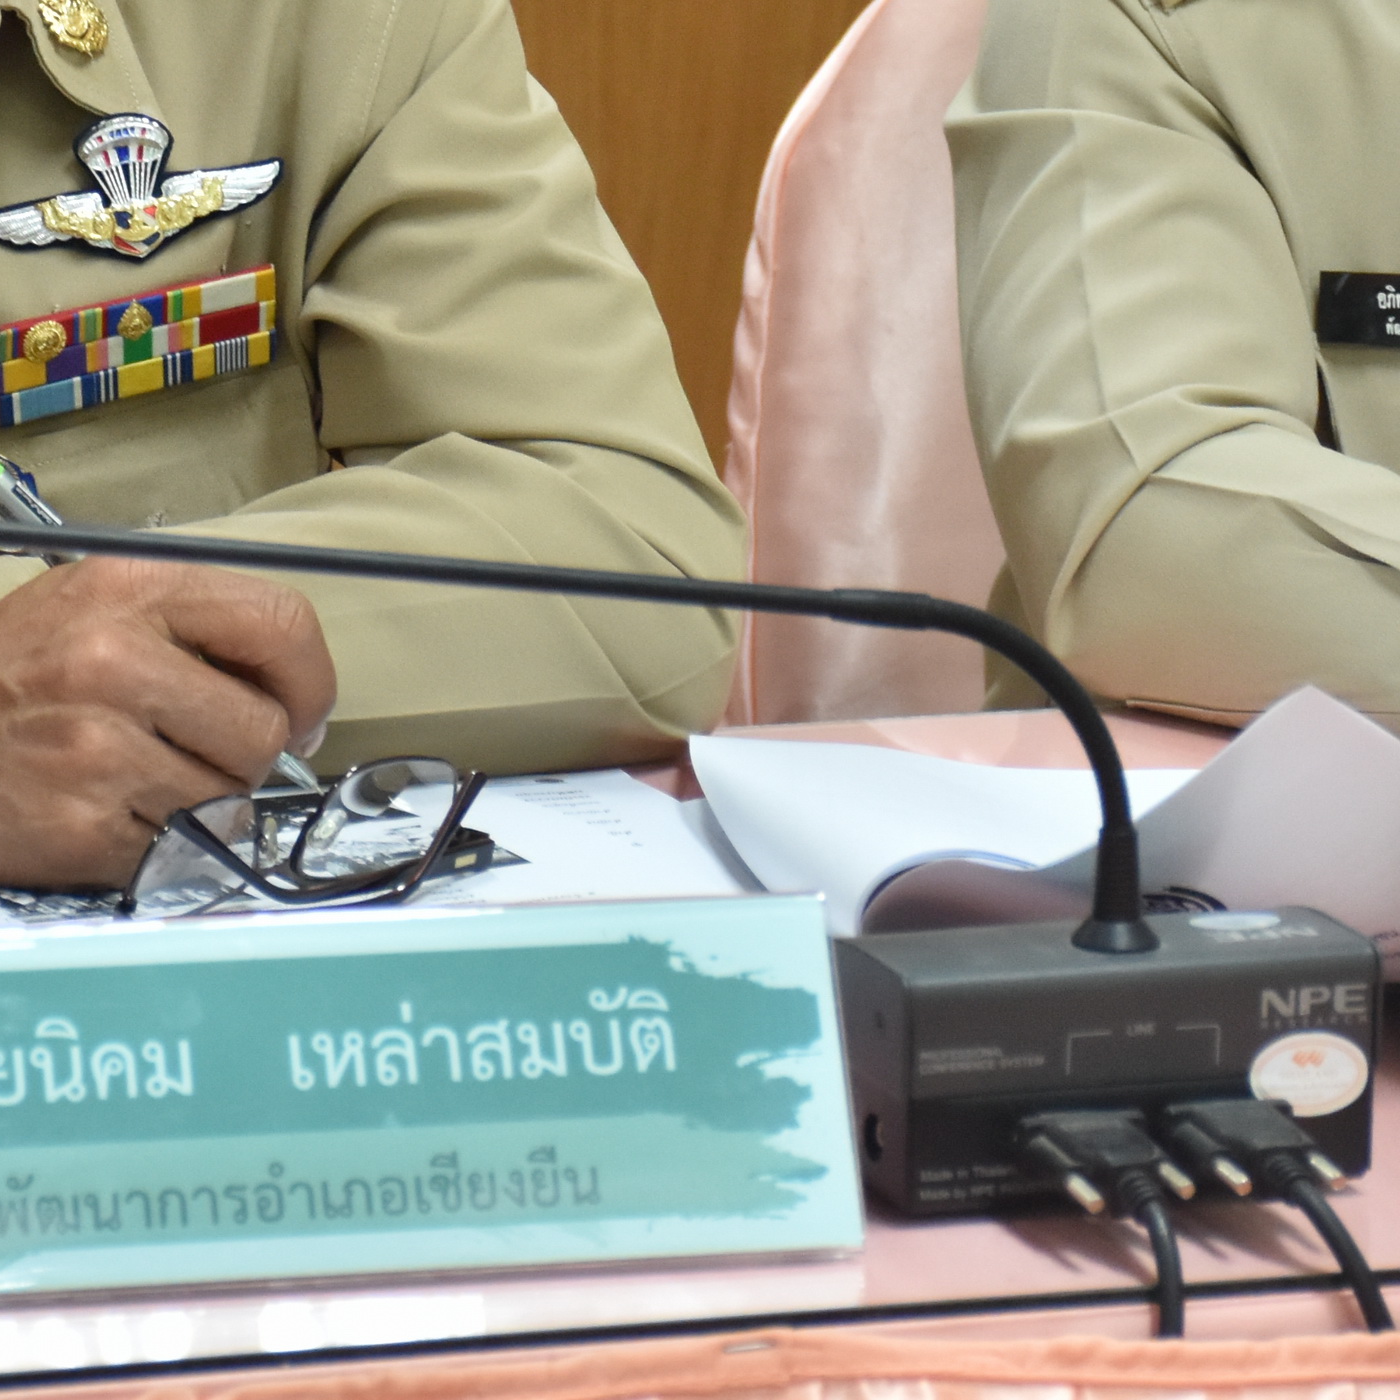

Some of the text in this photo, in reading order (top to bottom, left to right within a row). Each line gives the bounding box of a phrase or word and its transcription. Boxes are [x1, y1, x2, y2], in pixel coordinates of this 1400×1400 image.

[1260, 982, 1369, 1020] NPE
[288, 986, 678, 1091] เหล่าสมบัติ
